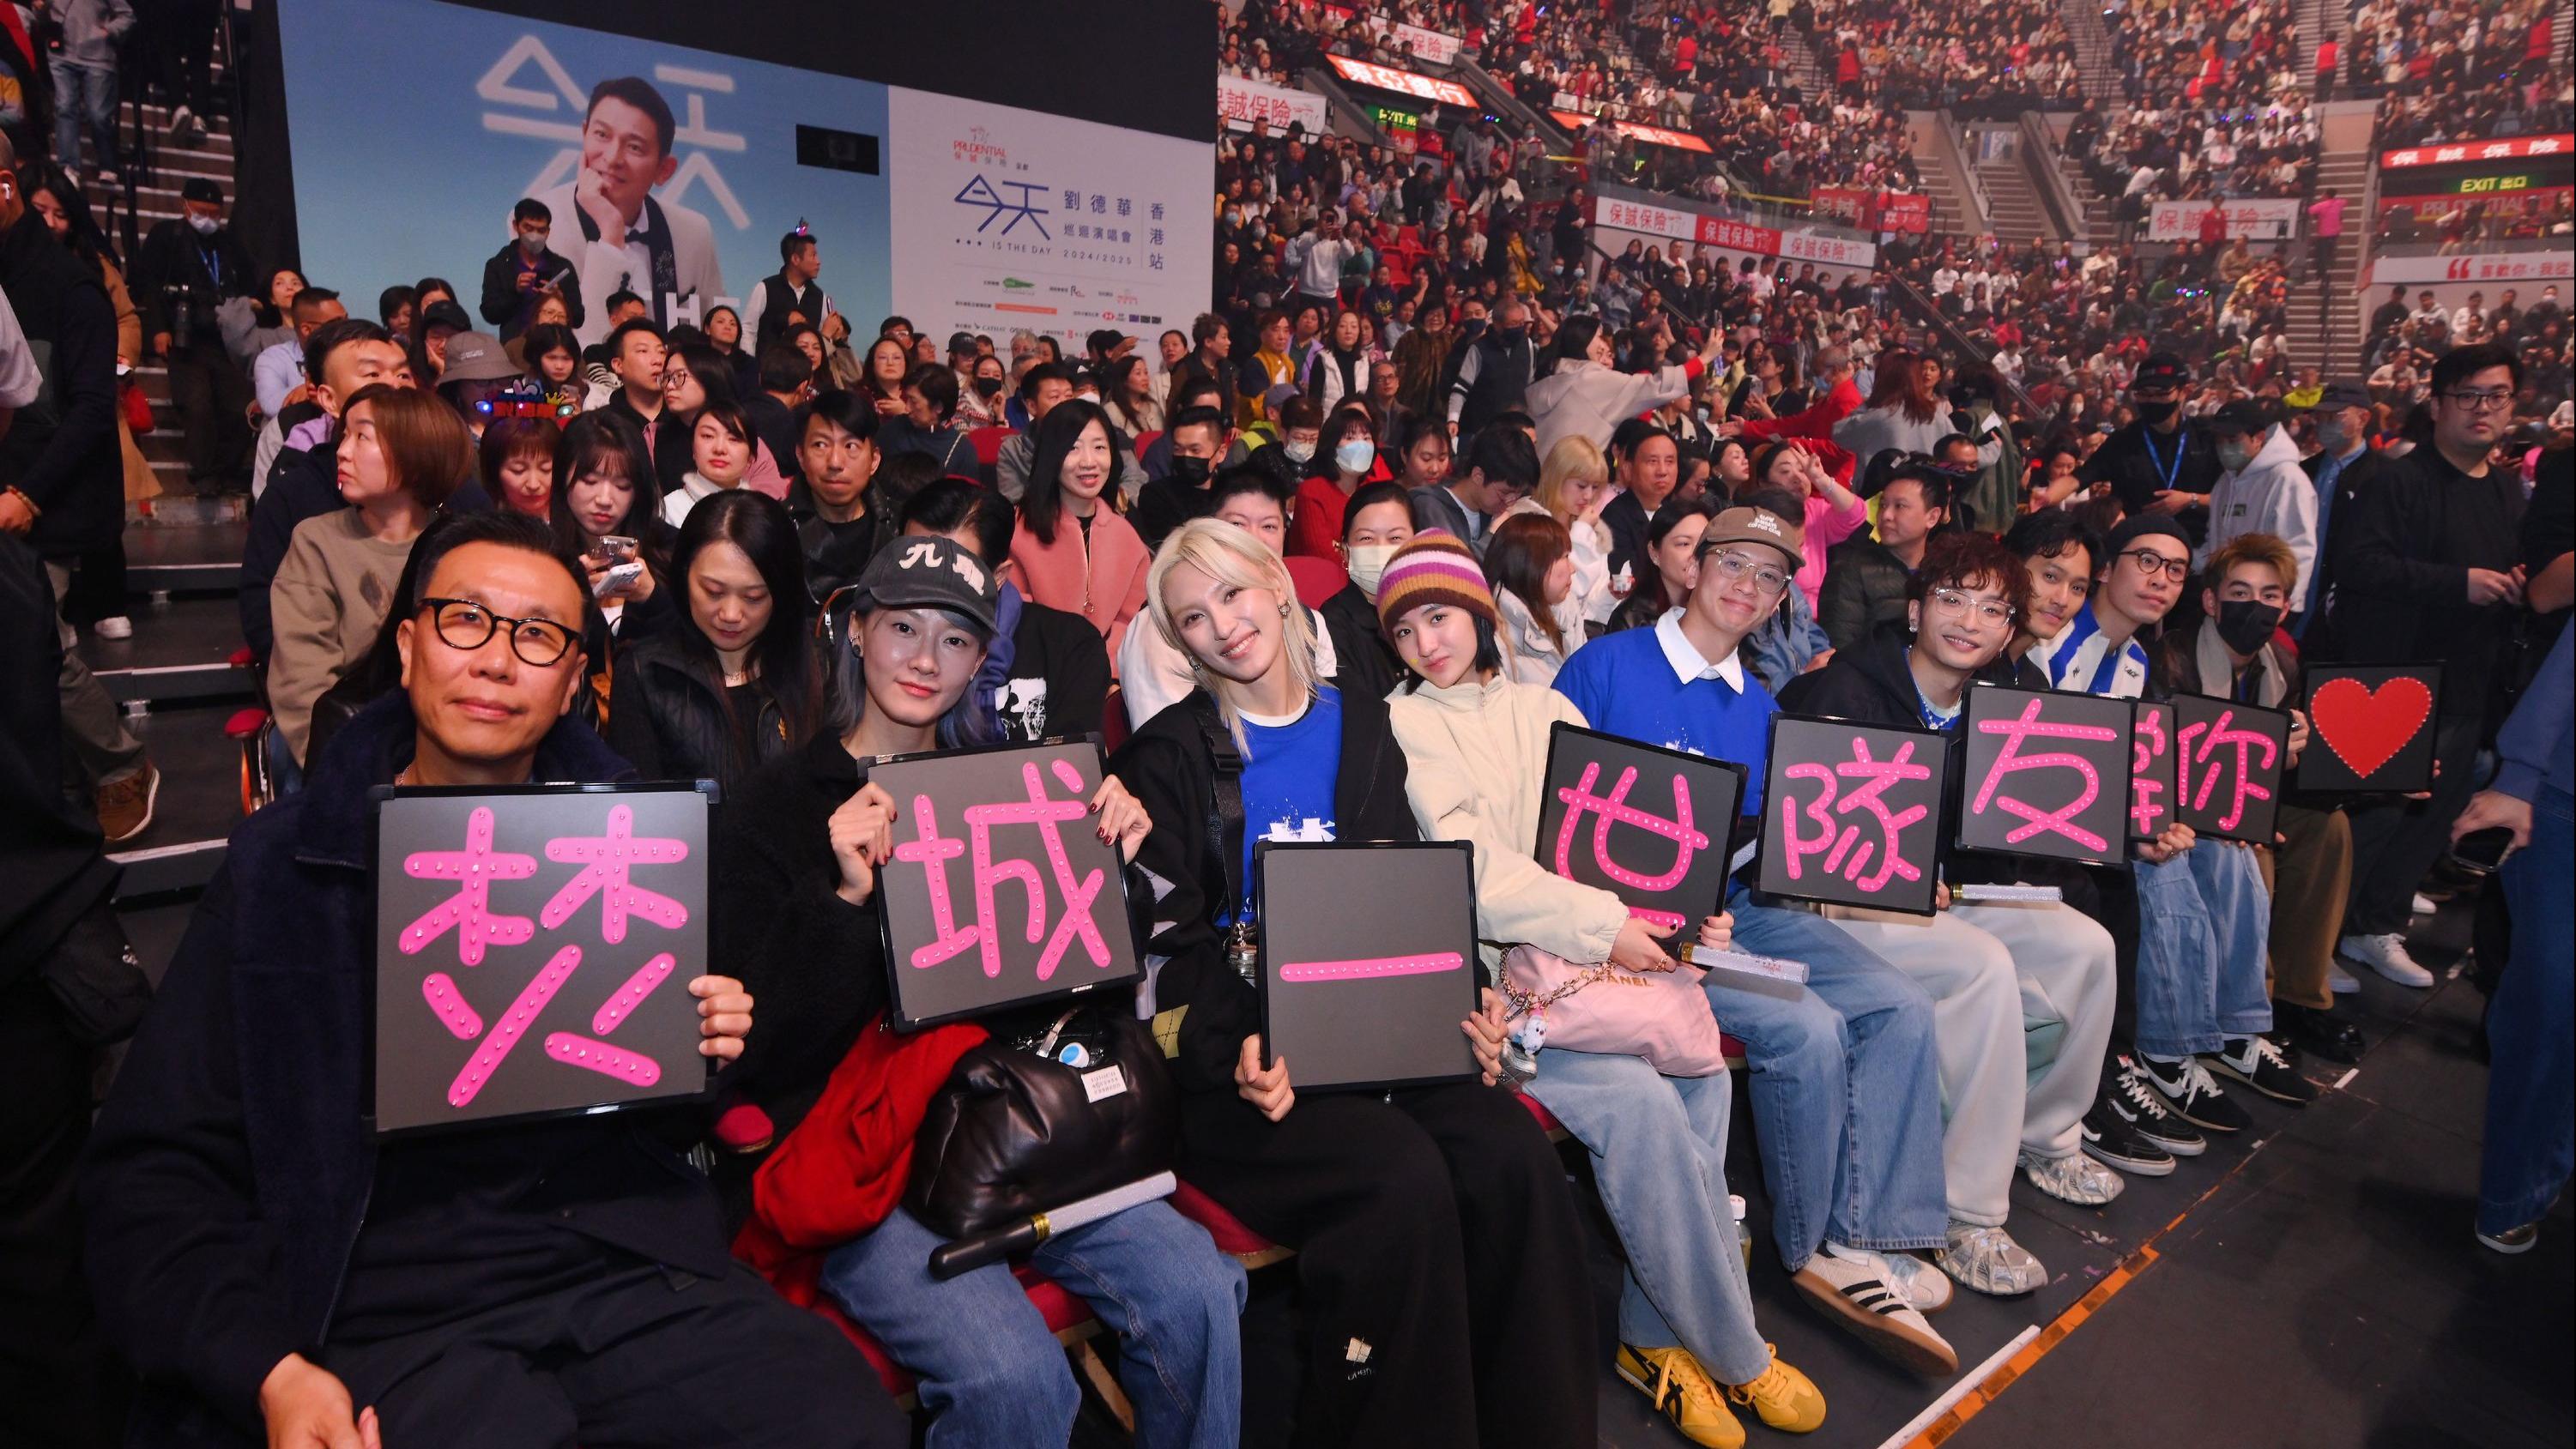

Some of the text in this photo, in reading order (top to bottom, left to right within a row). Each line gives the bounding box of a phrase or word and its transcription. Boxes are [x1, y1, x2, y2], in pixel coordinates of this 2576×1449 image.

[475, 35, 751, 230] 今天
[953, 140, 1008, 157] PRUDENTIAL
[954, 173, 1050, 241] 今天
[1064, 190, 1132, 216] 劉德華
[2460, 178, 2495, 193] EXIT
[1007, 243, 1027, 253] THE
[1064, 250, 1132, 265] 2024/2025
[1150, 203, 1164, 270] 香港站
[1973, 697, 2118, 852] 友
[2178, 710, 2277, 831] 你
[1782, 736, 1931, 893] 隊
[895, 759, 1112, 981] 城
[398, 804, 688, 1108] 焚
[1580, 969, 1654, 987] CANEL
